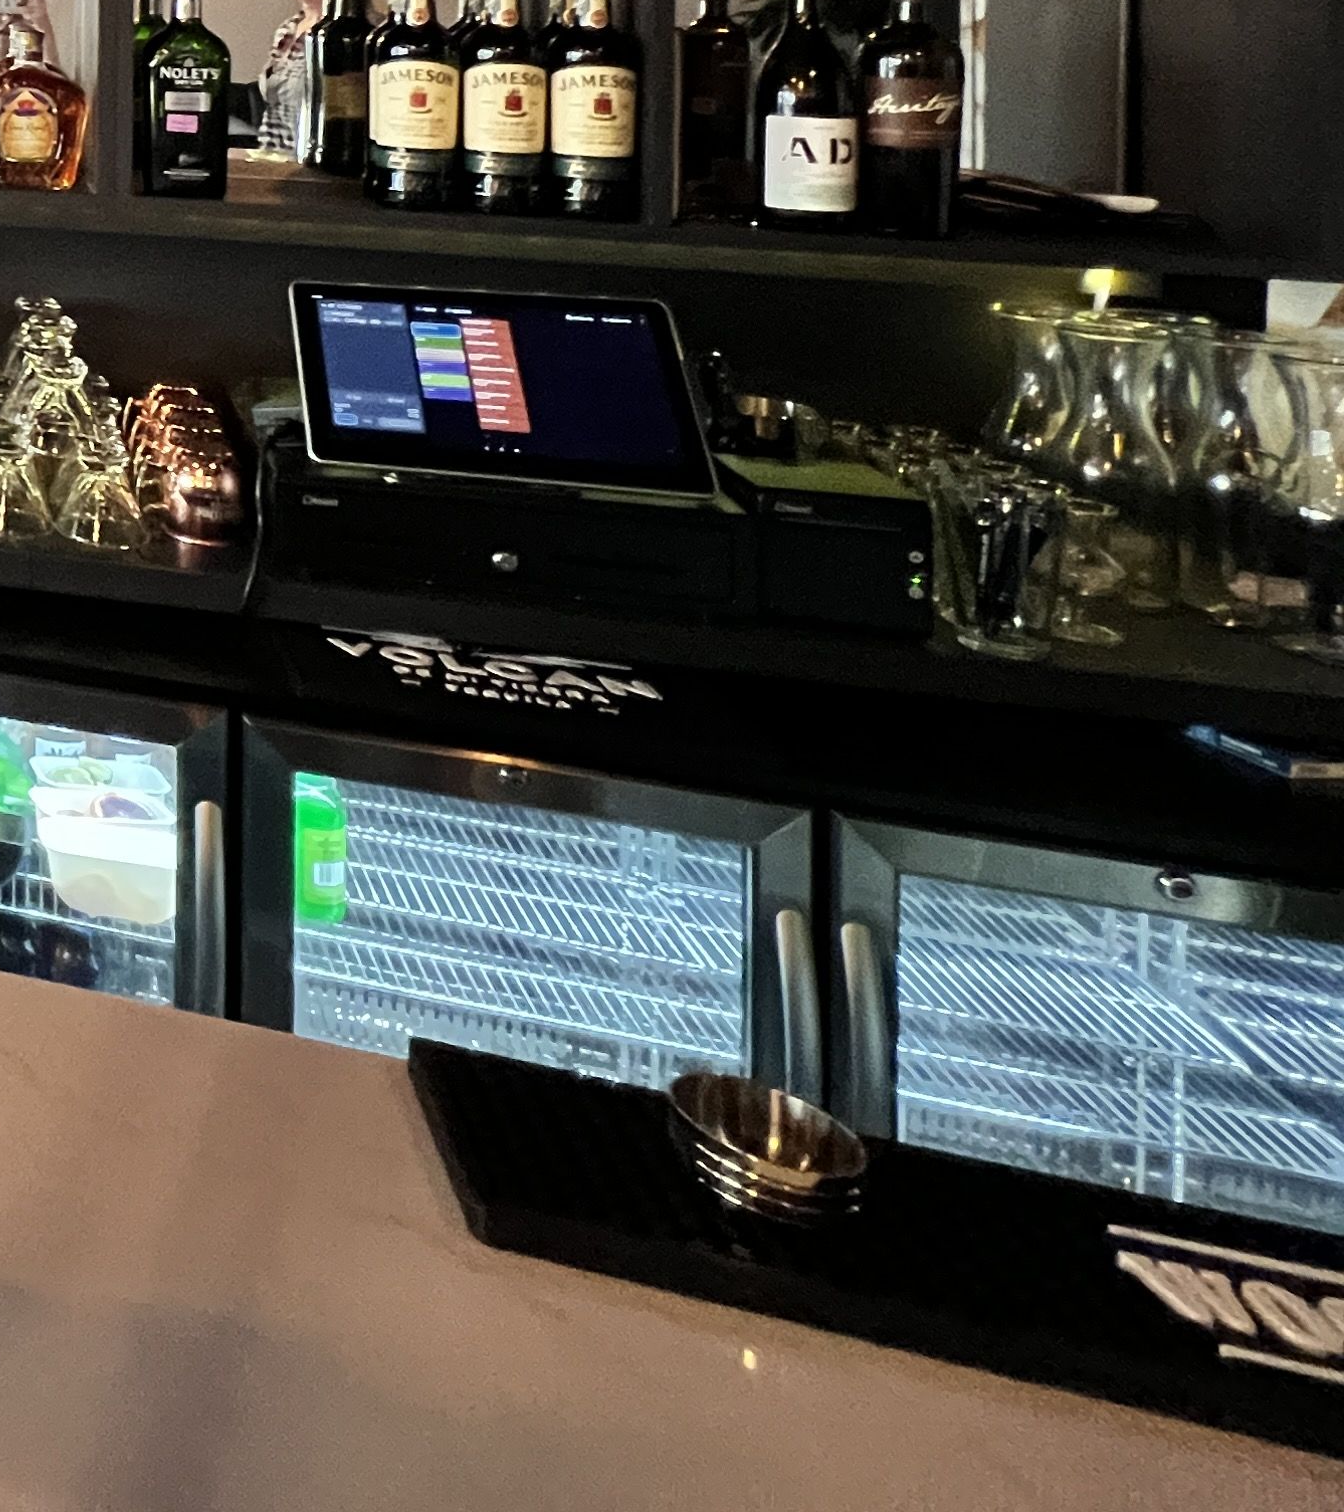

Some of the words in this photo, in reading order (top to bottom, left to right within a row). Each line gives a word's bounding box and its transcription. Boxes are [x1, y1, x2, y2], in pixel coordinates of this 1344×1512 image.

[380, 68, 454, 87] JAMESON
[326, 637, 664, 700] VOLCAN
[1115, 1250, 1344, 1357] WO
